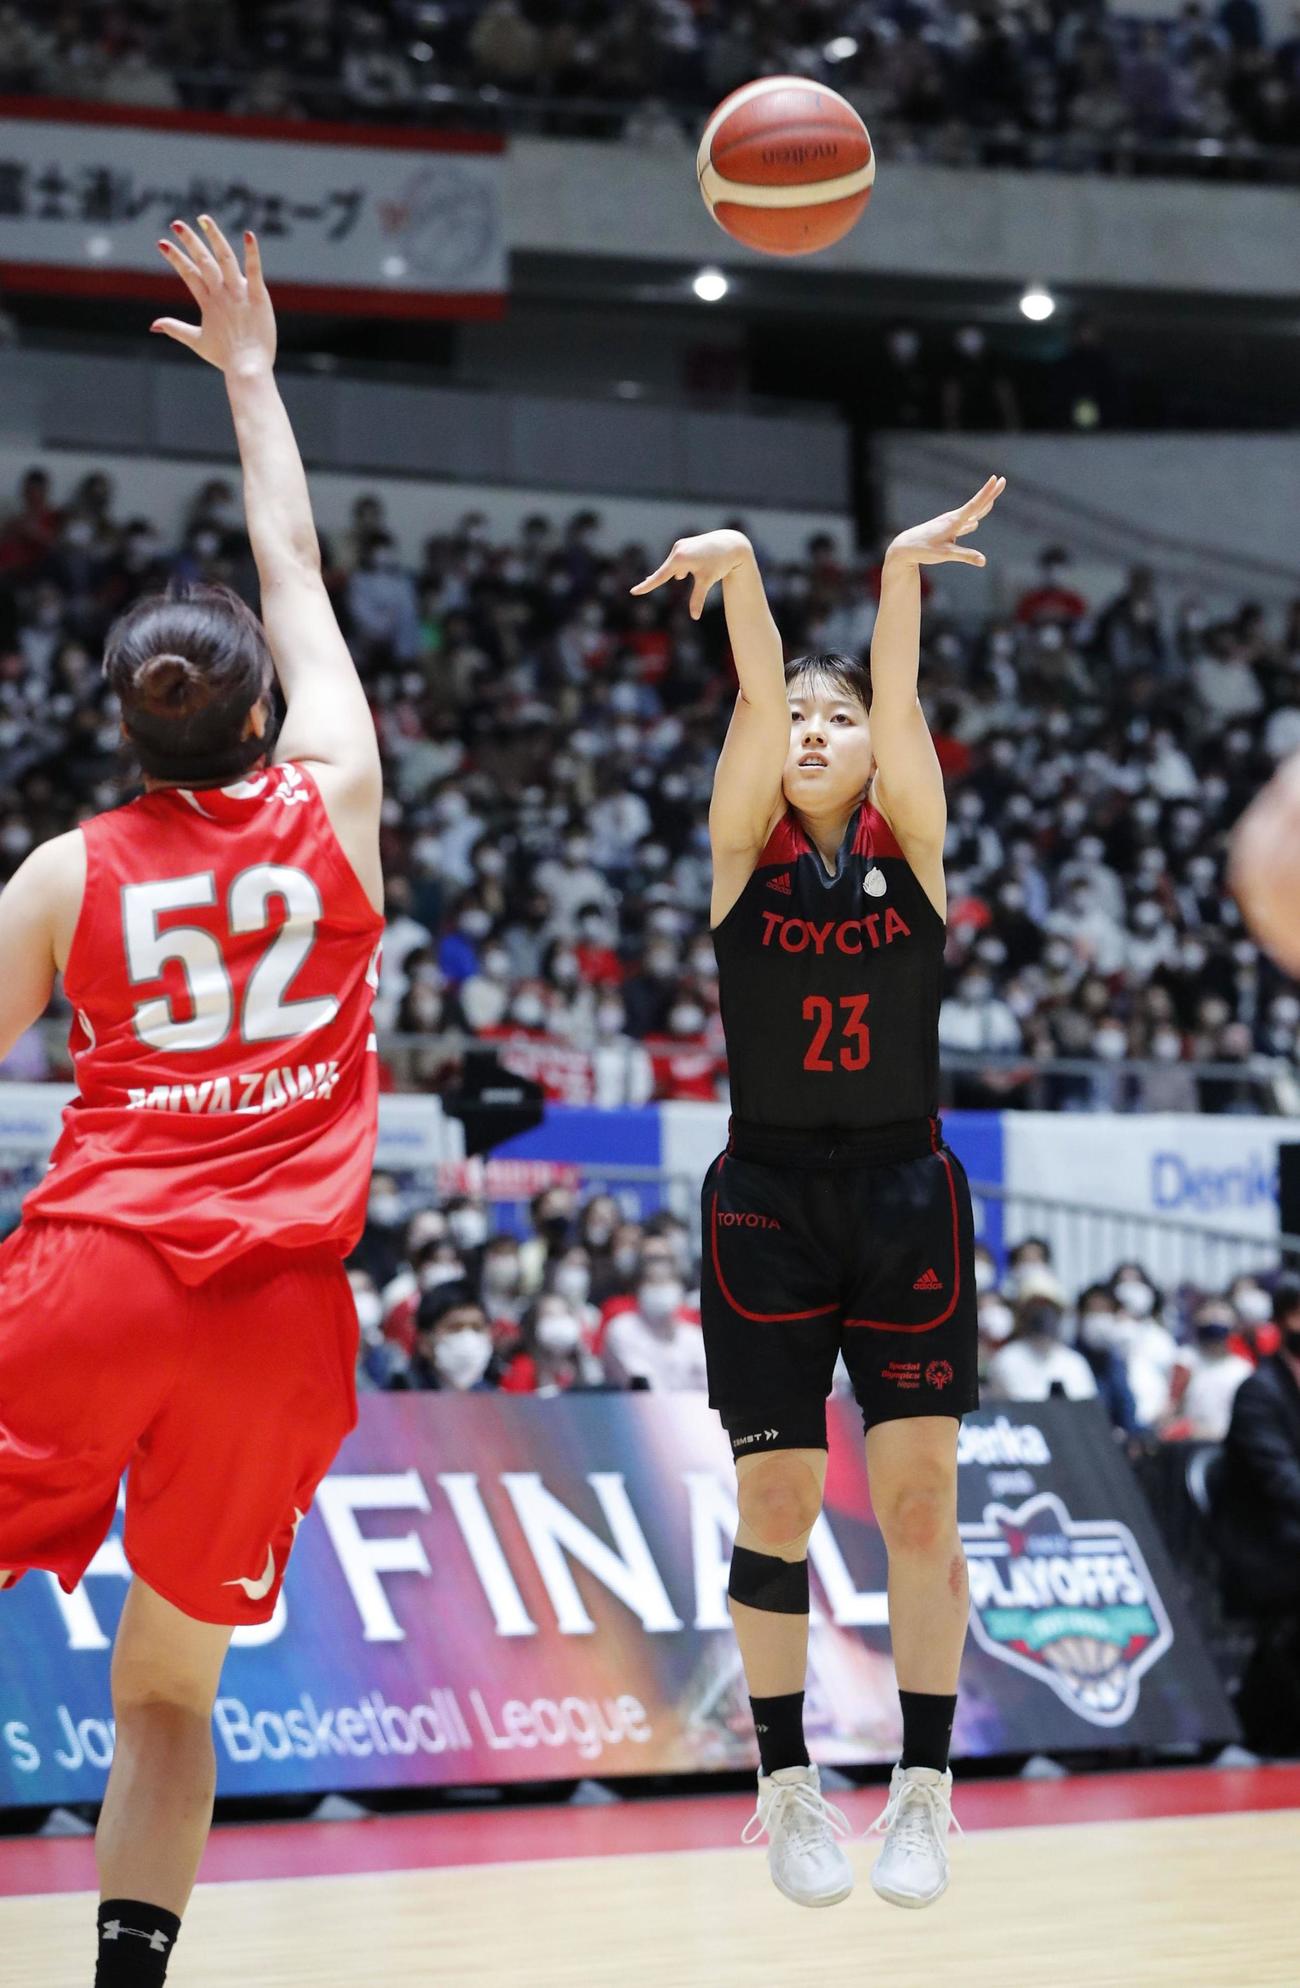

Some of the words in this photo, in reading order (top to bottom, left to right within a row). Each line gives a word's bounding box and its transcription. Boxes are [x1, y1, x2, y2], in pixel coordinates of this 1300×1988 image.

[120, 861, 340, 1053] 52
[760, 907, 912, 955] TOYOTA
[802, 993, 871, 1072] 23
[1152, 1151, 1280, 1209] Denk
[717, 1212, 781, 1230] TOYOTA
[912, 1281, 944, 1291] adidas
[213, 1687, 473, 1763] Basketball
[469, 1688, 652, 1760] League
